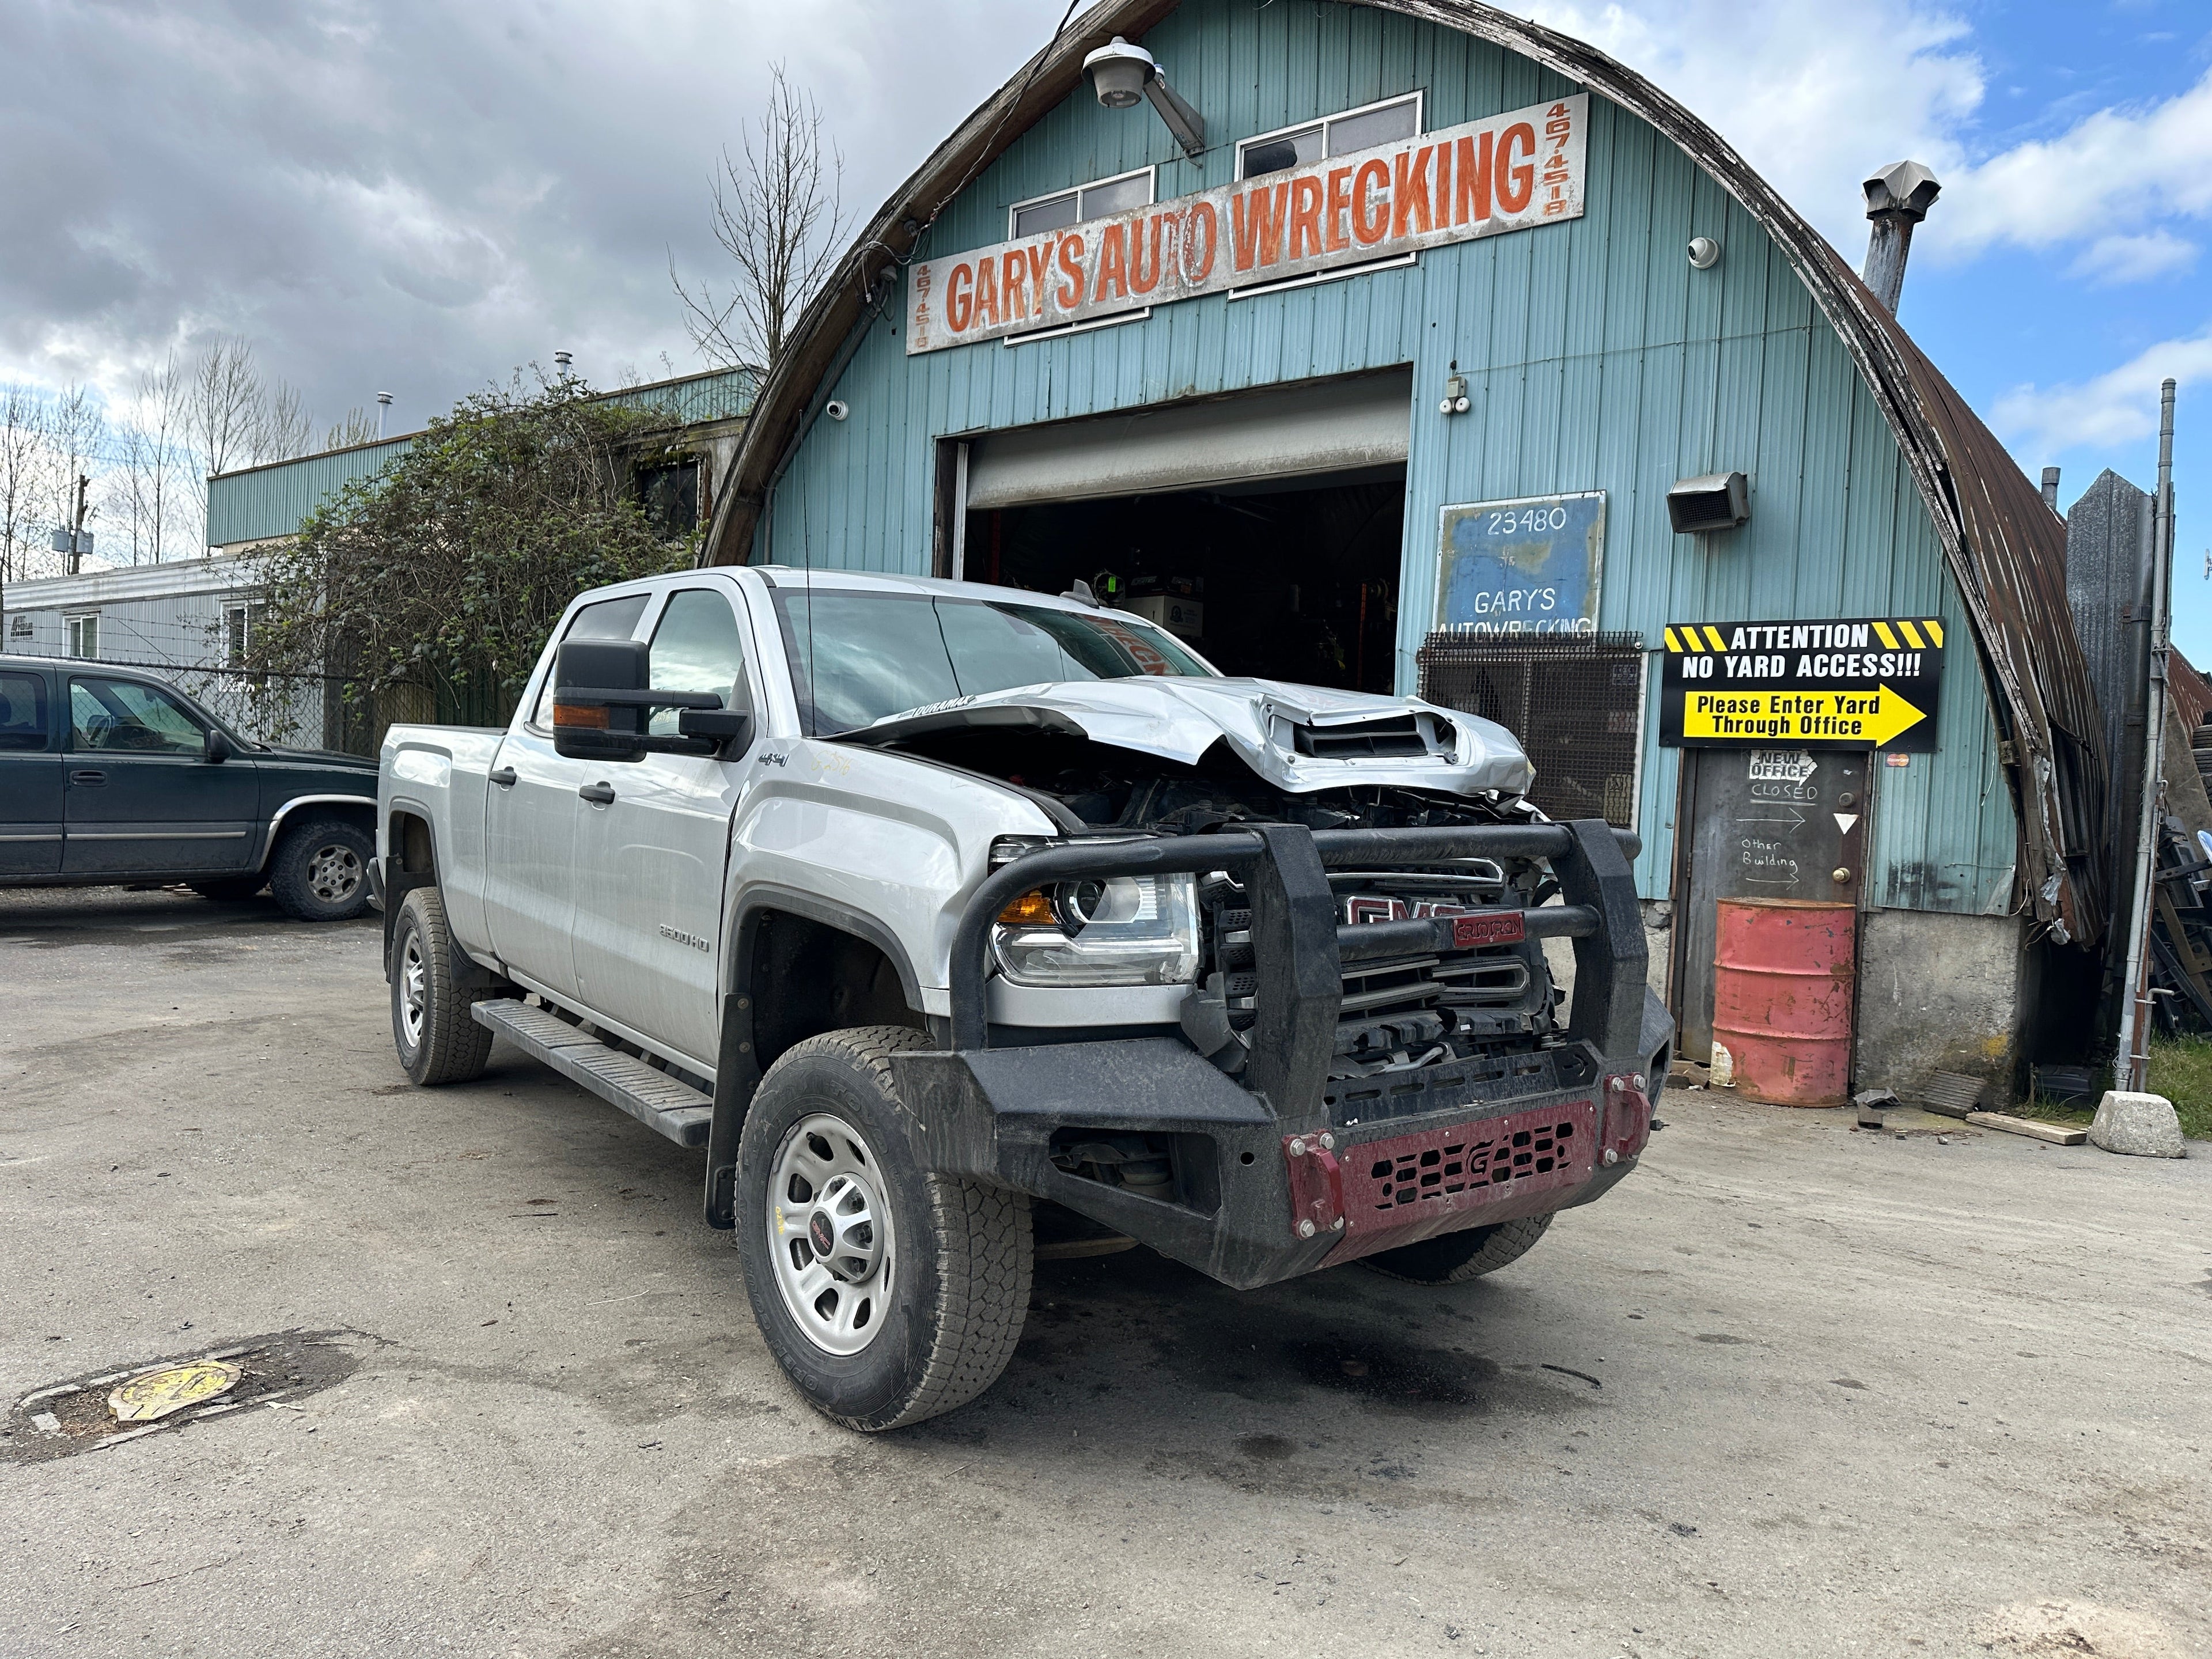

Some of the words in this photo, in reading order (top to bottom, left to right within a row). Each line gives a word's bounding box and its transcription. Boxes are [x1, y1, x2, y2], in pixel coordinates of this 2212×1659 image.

[946, 230, 1085, 333] GARY'S
[1094, 202, 1217, 303] AUTO
[1232, 122, 1536, 272] WRECKING
[1487, 506, 1567, 536] 23480
[1475, 588, 1556, 614] GARY'S
[1730, 623, 1870, 651] ATTENTION
[1681, 656, 1714, 679] NO
[1725, 655, 1786, 678] YARD
[1796, 653, 1922, 677] ACCESS!!!
[1697, 695, 1760, 713] Please
[1770, 696, 1824, 715] Enter
[1834, 696, 1880, 715] Yard
[1712, 715, 1791, 737] Through
[1800, 717, 1862, 736] Office
[1760, 752, 1799, 764] NEW
[1751, 764, 1809, 778] OFFICE
[1752, 784, 1818, 800] CLOSED
[1743, 851, 1798, 874] Building
[1457, 919, 1523, 941] GRIDIRON
[771, 1339, 819, 1391] OPEN
